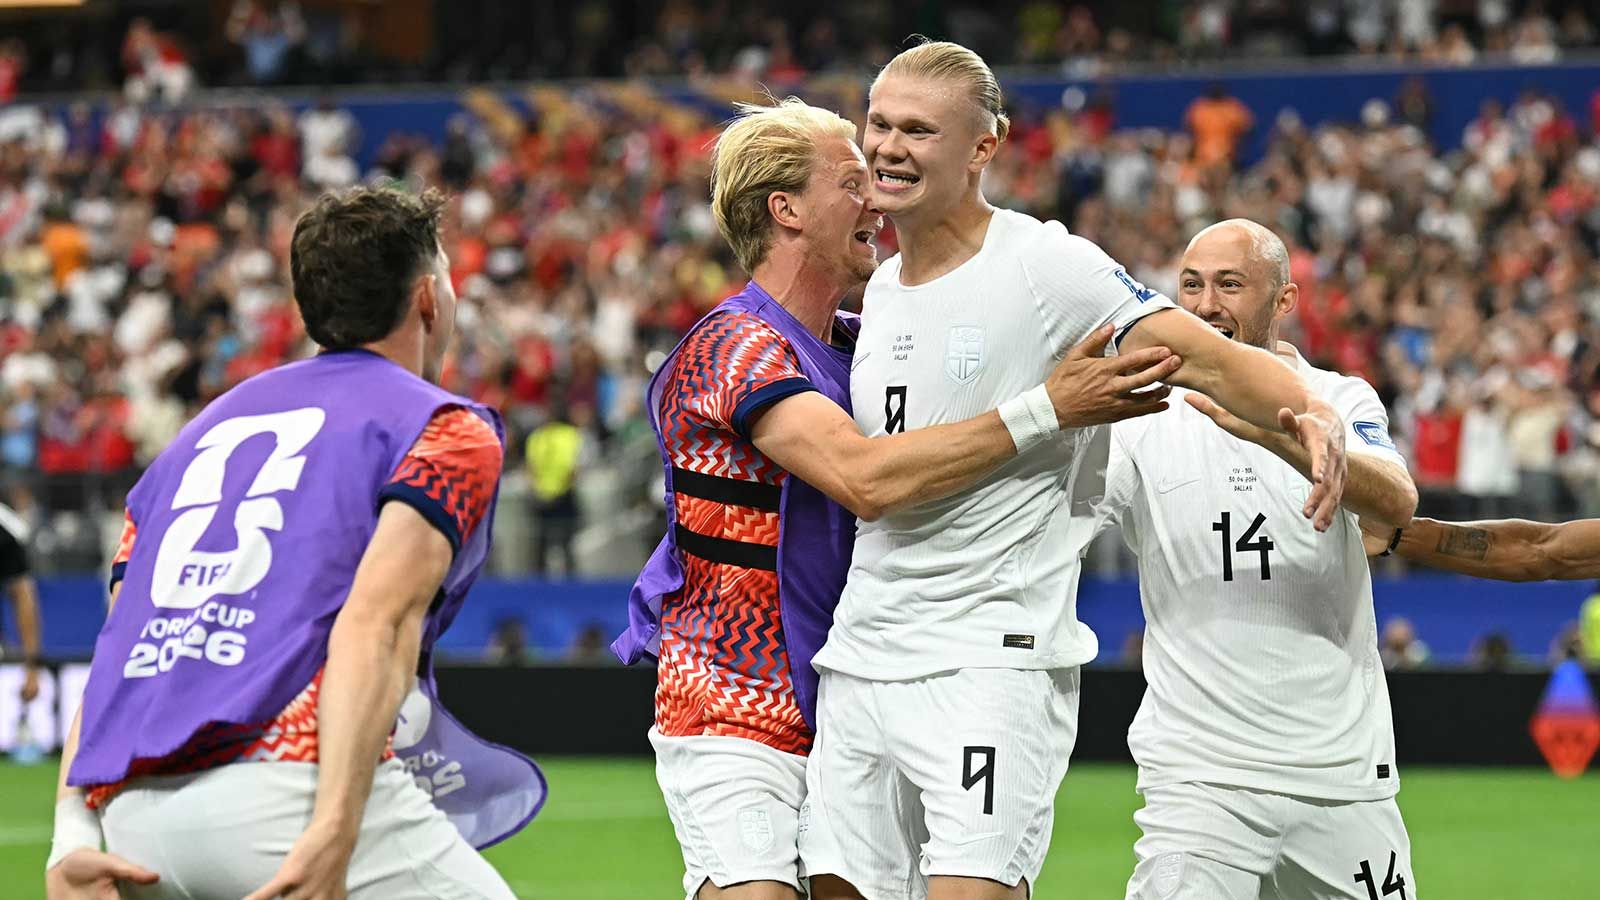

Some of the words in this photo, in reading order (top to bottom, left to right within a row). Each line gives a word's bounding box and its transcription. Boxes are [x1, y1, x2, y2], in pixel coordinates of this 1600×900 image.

[1212, 511, 1274, 581] 14
[201, 602, 256, 629] CUP
[961, 746, 996, 815] 9
[1353, 850, 1407, 900] 14
